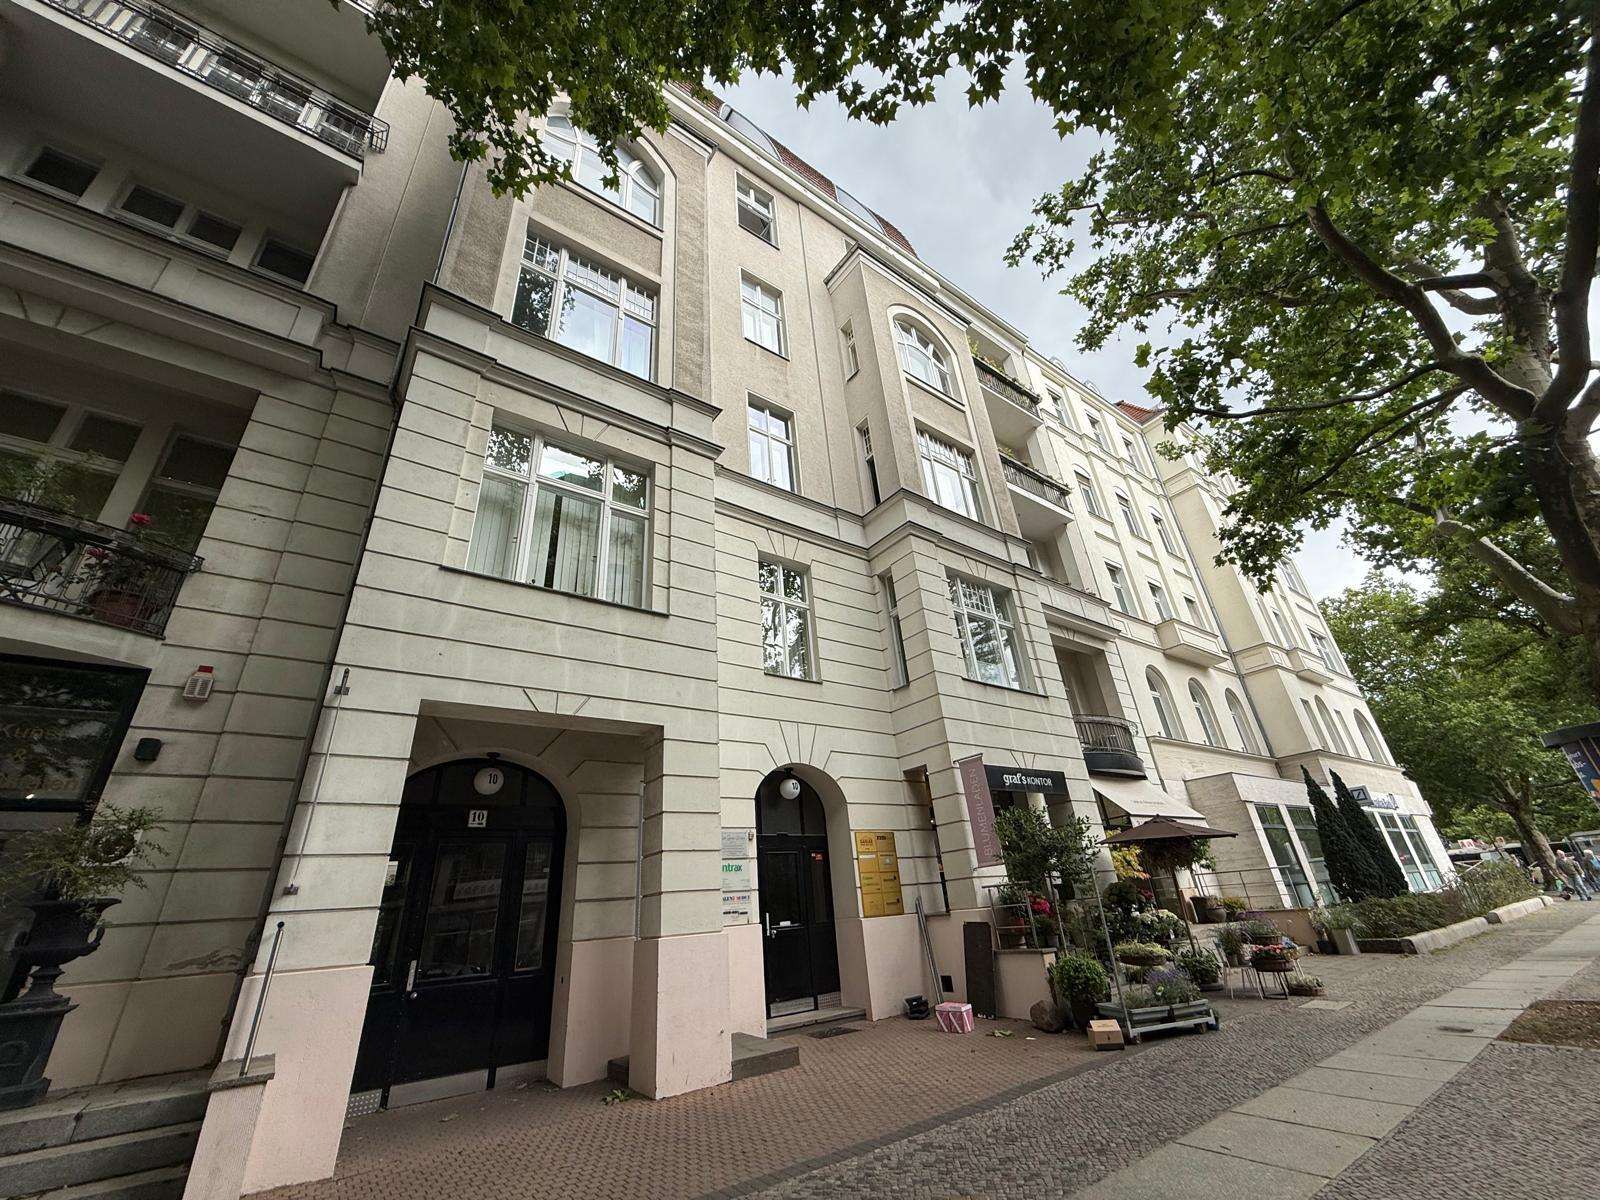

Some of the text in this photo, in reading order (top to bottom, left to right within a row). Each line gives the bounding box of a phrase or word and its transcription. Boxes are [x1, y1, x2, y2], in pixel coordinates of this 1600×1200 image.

[487, 773, 498, 784] 10
[1003, 773, 1053, 787] graf's KONTOR
[472, 811, 485, 822] 10
[968, 768, 993, 856] BLUMENLADEN
